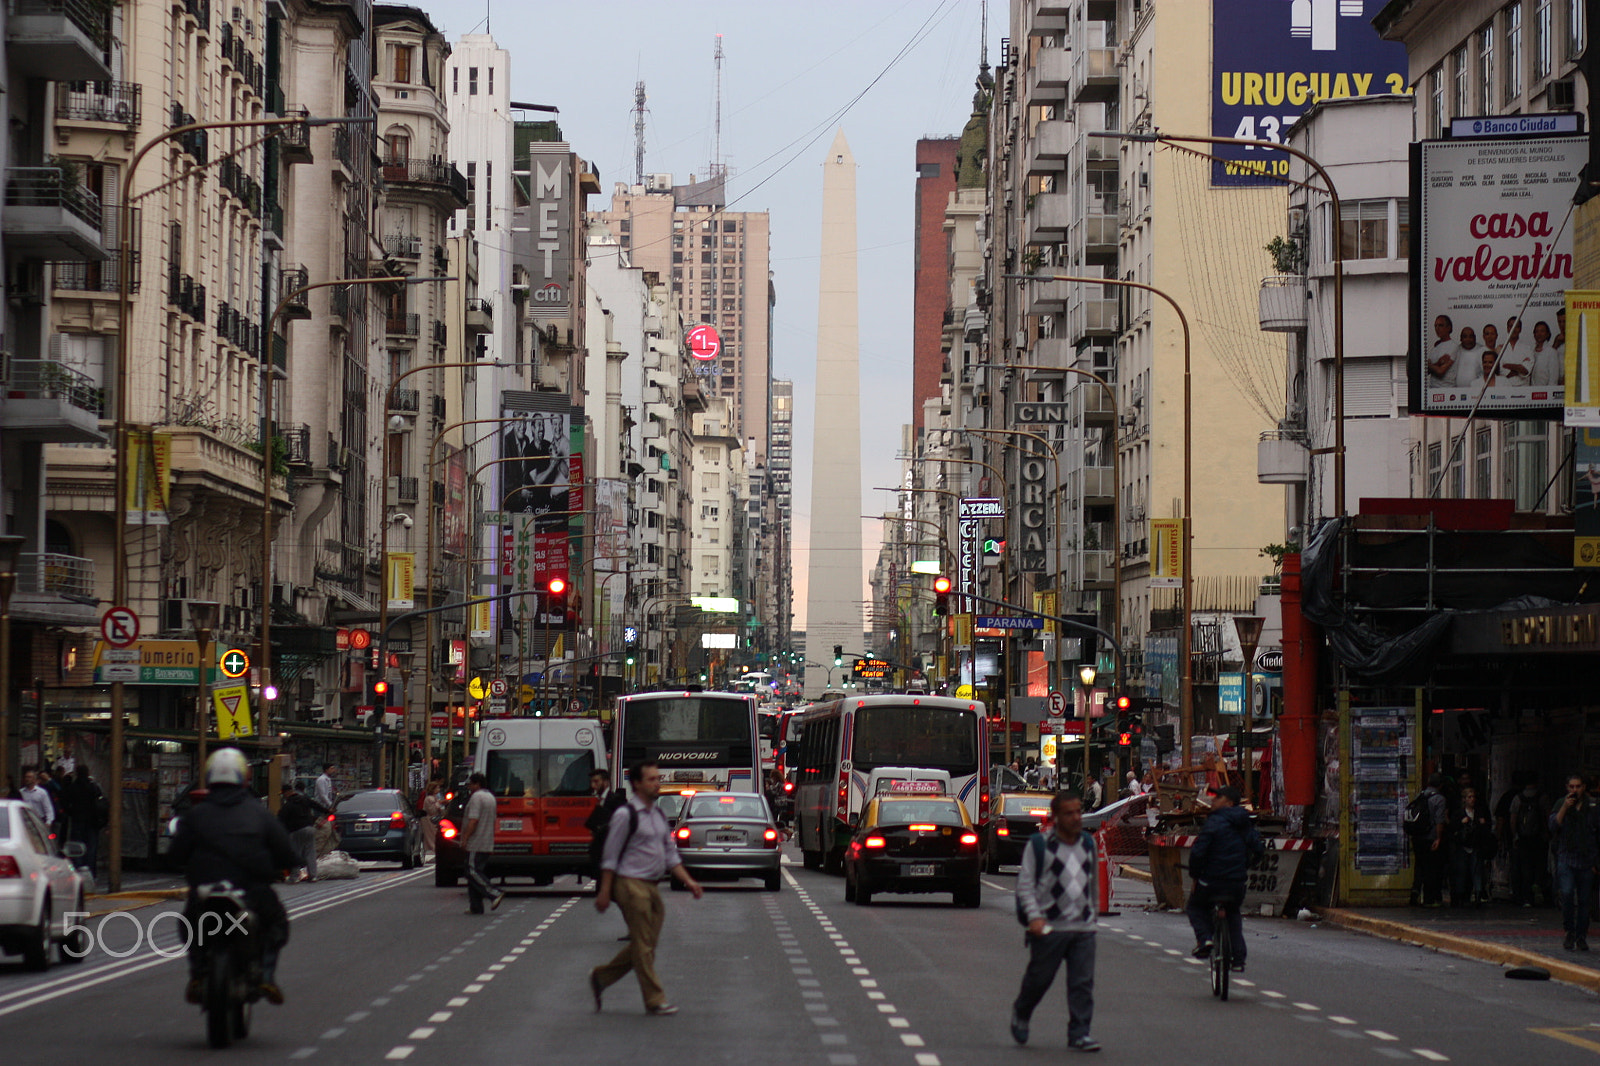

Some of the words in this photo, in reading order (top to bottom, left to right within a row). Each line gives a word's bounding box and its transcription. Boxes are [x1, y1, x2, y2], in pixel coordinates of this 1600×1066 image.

[1221, 72, 1373, 106] URUGUAY
[1484, 120, 1518, 133] Banco
[1519, 118, 1557, 131] Ciudad
[1477, 157, 1498, 165] ESTAS
[1498, 156, 1528, 164] MUJERES
[1528, 154, 1566, 163] ESPECIALES
[1478, 148, 1519, 157] BIENVENIDOS
[1519, 147, 1527, 155] AL
[536, 160, 562, 279] MET
[1469, 211, 1553, 240] casa
[1433, 242, 1574, 283] valentin
[534, 286, 561, 302] citi
[1018, 406, 1069, 421] CIN
[1022, 437, 1045, 552] LORCA
[486, 513, 508, 523] LOS
[986, 618, 1034, 628] PARANA
[658, 751, 719, 761] NUOVOBUS
[841, 762, 852, 771] 60
